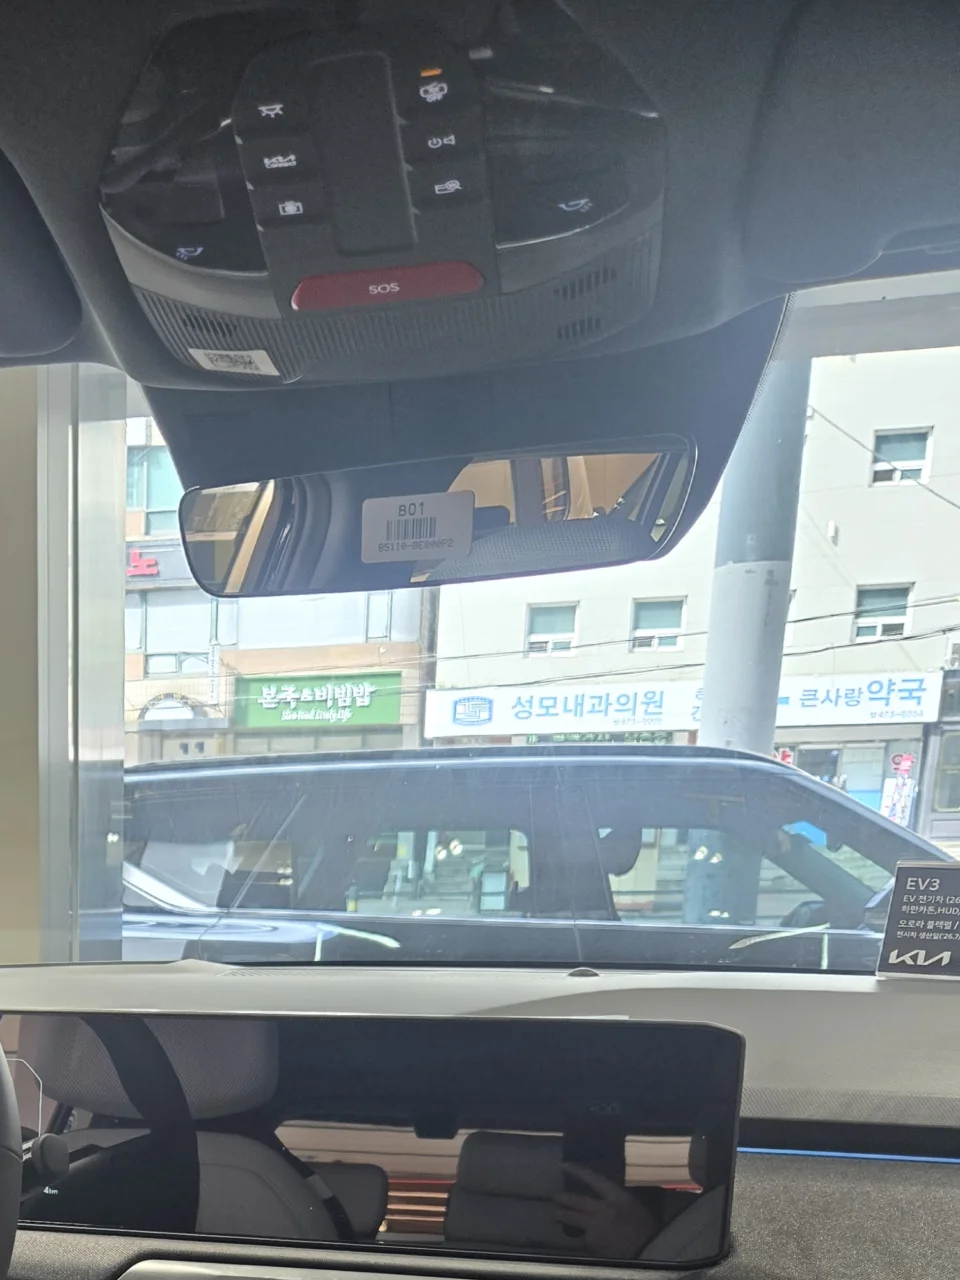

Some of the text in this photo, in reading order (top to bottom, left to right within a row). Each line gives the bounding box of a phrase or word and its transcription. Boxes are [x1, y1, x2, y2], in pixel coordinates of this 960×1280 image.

[368, 282, 400, 295] SOS
[398, 501, 425, 517] B01
[511, 690, 665, 720] 성모내과의원
[906, 877, 941, 891] EV3
[903, 894, 917, 903] EV
[898, 919, 925, 929] 오로라
[888, 948, 952, 967] KIA
